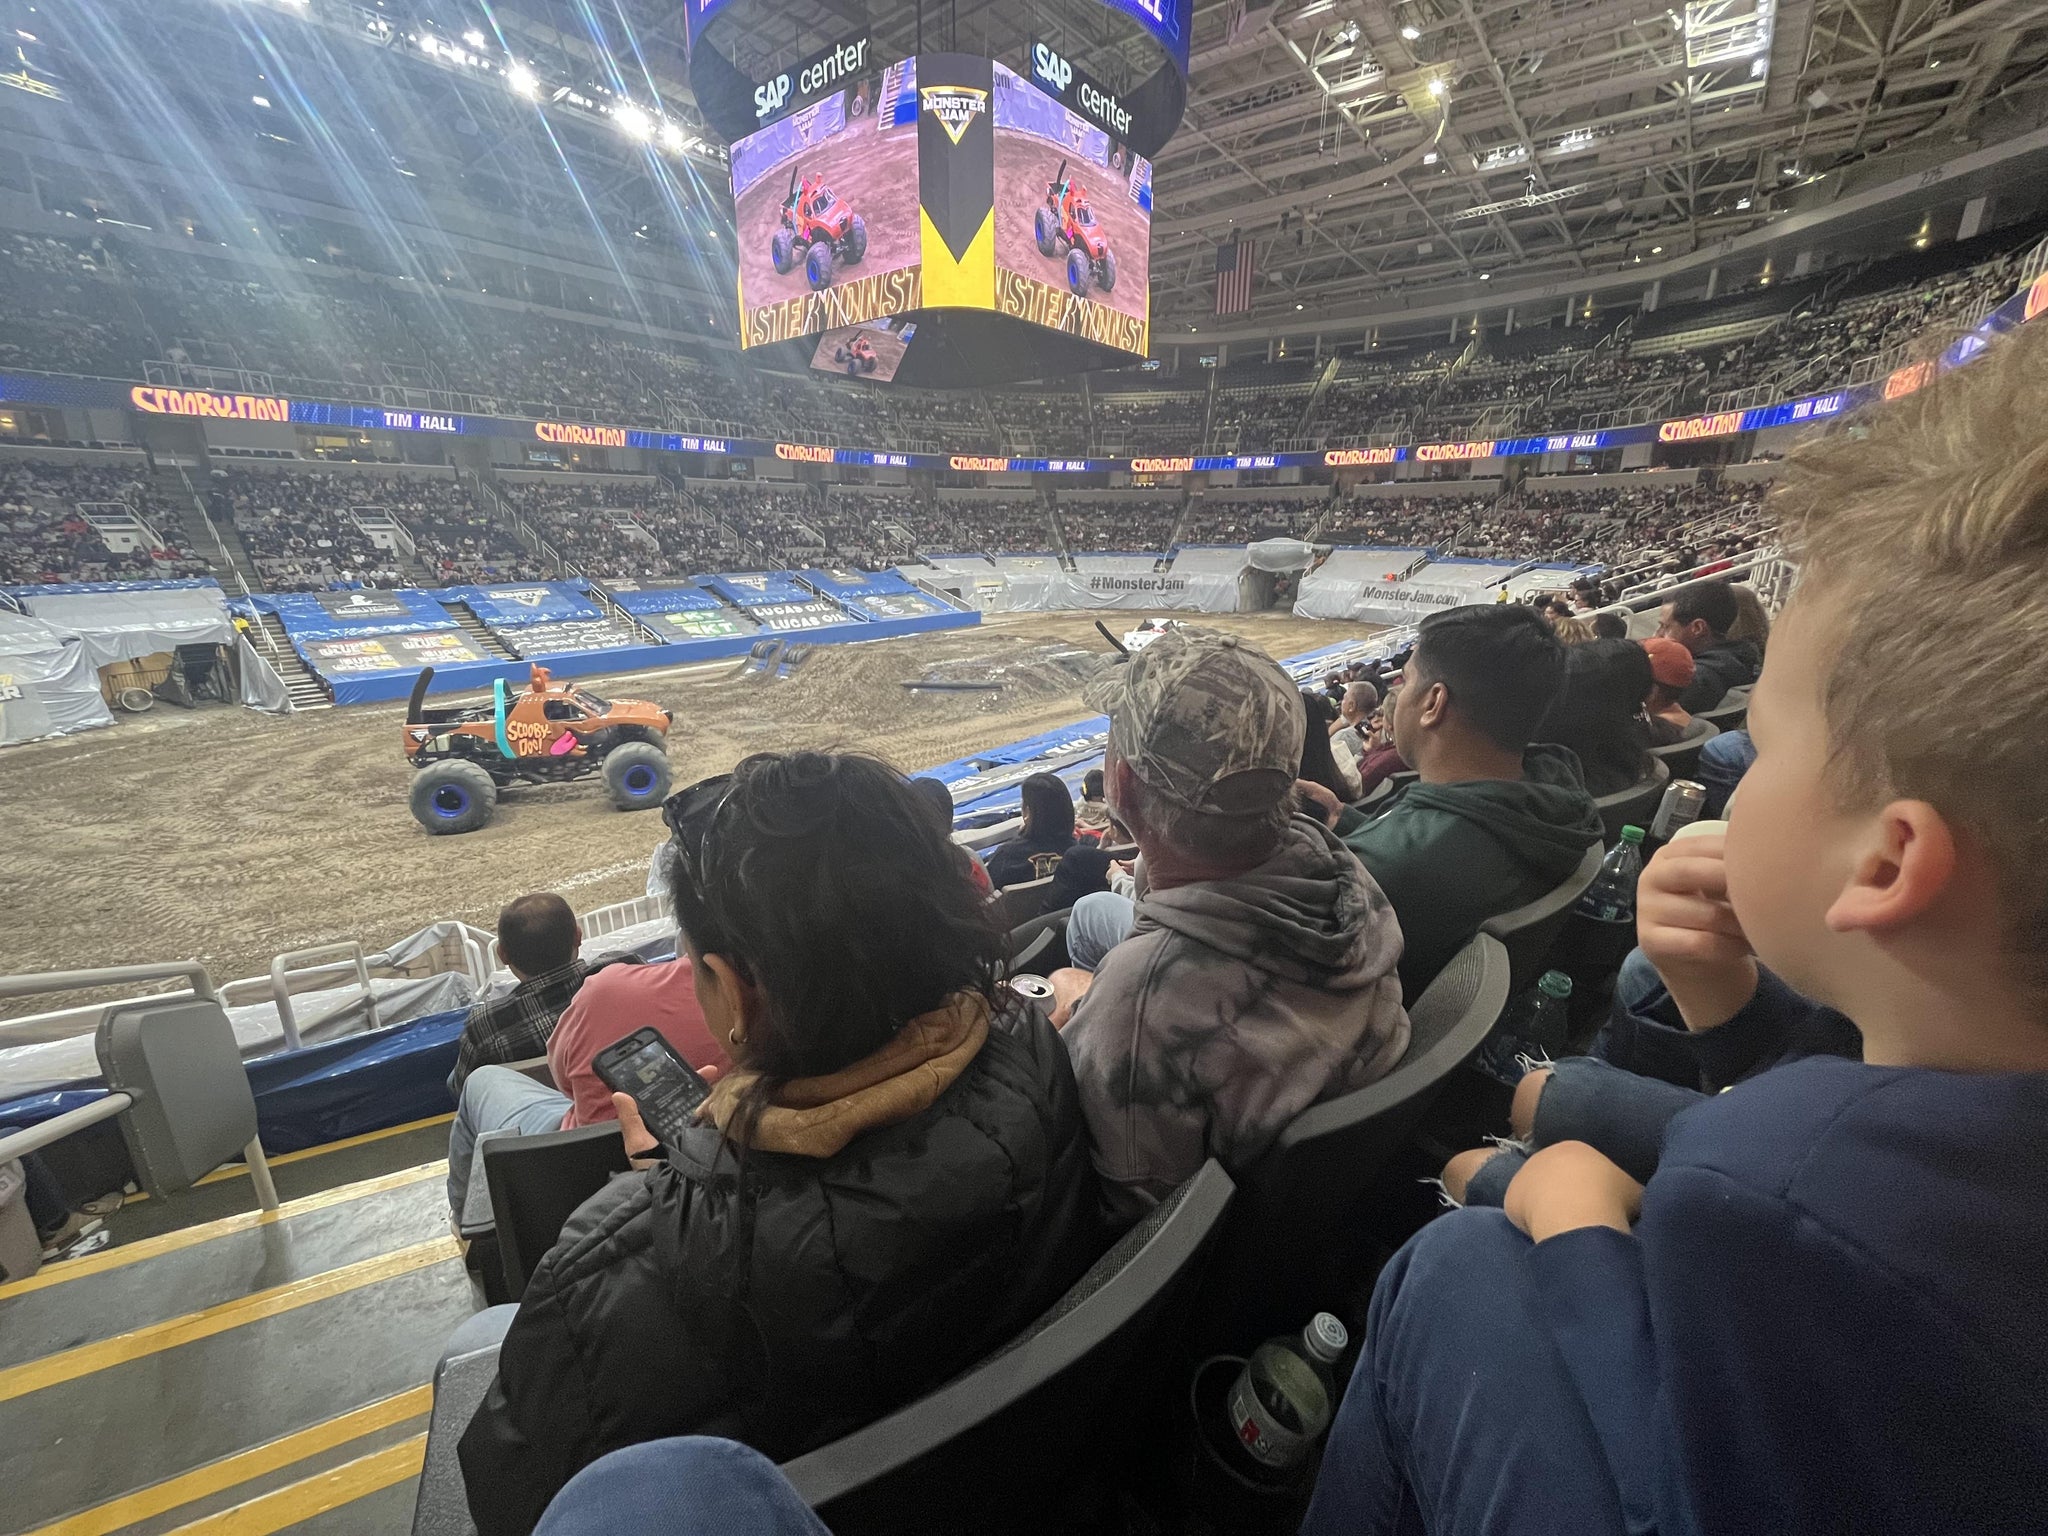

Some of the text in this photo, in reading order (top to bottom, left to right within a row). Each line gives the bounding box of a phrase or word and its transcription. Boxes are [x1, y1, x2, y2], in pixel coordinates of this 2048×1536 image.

[754, 38, 867, 118] SAP center
[1035, 42, 1133, 135] SAP center
[923, 96, 987, 113] MONSTER
[940, 108, 970, 121] JAM
[1813, 396, 1839, 415] HALL
[384, 412, 456, 431] TIM HALL
[682, 437, 726, 452] TIM HALL
[1547, 433, 1598, 449] TIM HALL
[873, 454, 907, 465] TIM HALL
[1048, 461, 1085, 470] TIM HALL
[1236, 457, 1275, 467] TIM HALL
[1090, 576, 1184, 590] #MonsterJam
[1362, 586, 1459, 606] MonsterJam.com
[753, 602, 832, 617] LUCAS OIL
[497, 620, 610, 636] Great Clips
[769, 613, 847, 630] LUCAS OIL
[514, 633, 629, 651] Great Clips
[507, 720, 552, 741] SCOOBY-
[518, 738, 543, 757] DOO!
